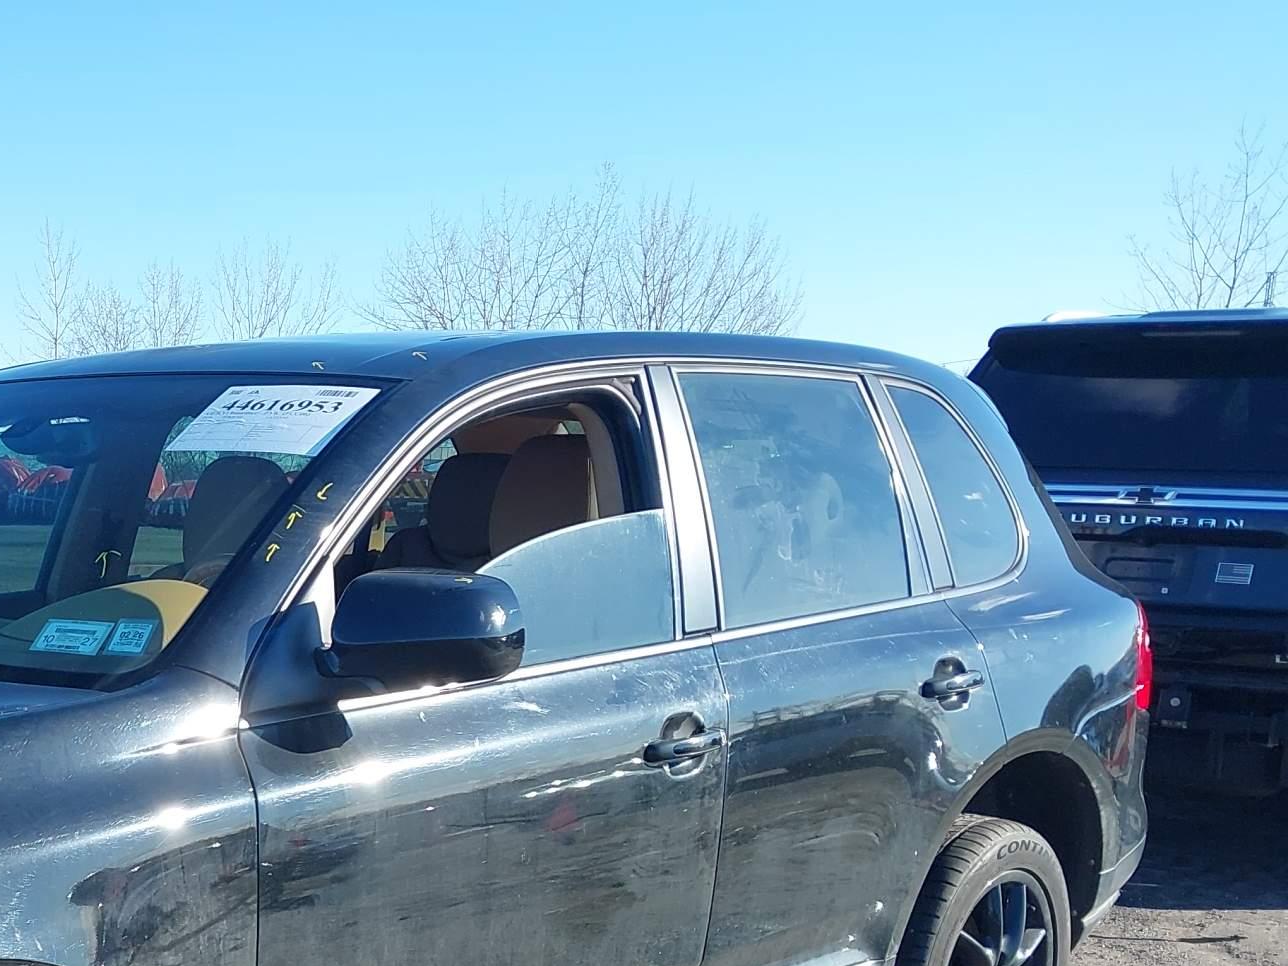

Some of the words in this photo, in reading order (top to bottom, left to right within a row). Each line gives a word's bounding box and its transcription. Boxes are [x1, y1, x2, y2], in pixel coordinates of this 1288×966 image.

[222, 399, 344, 414] 44616953
[1062, 511, 1245, 529] UBURBAN
[42, 634, 56, 644] 10
[80, 637, 98, 647] 27
